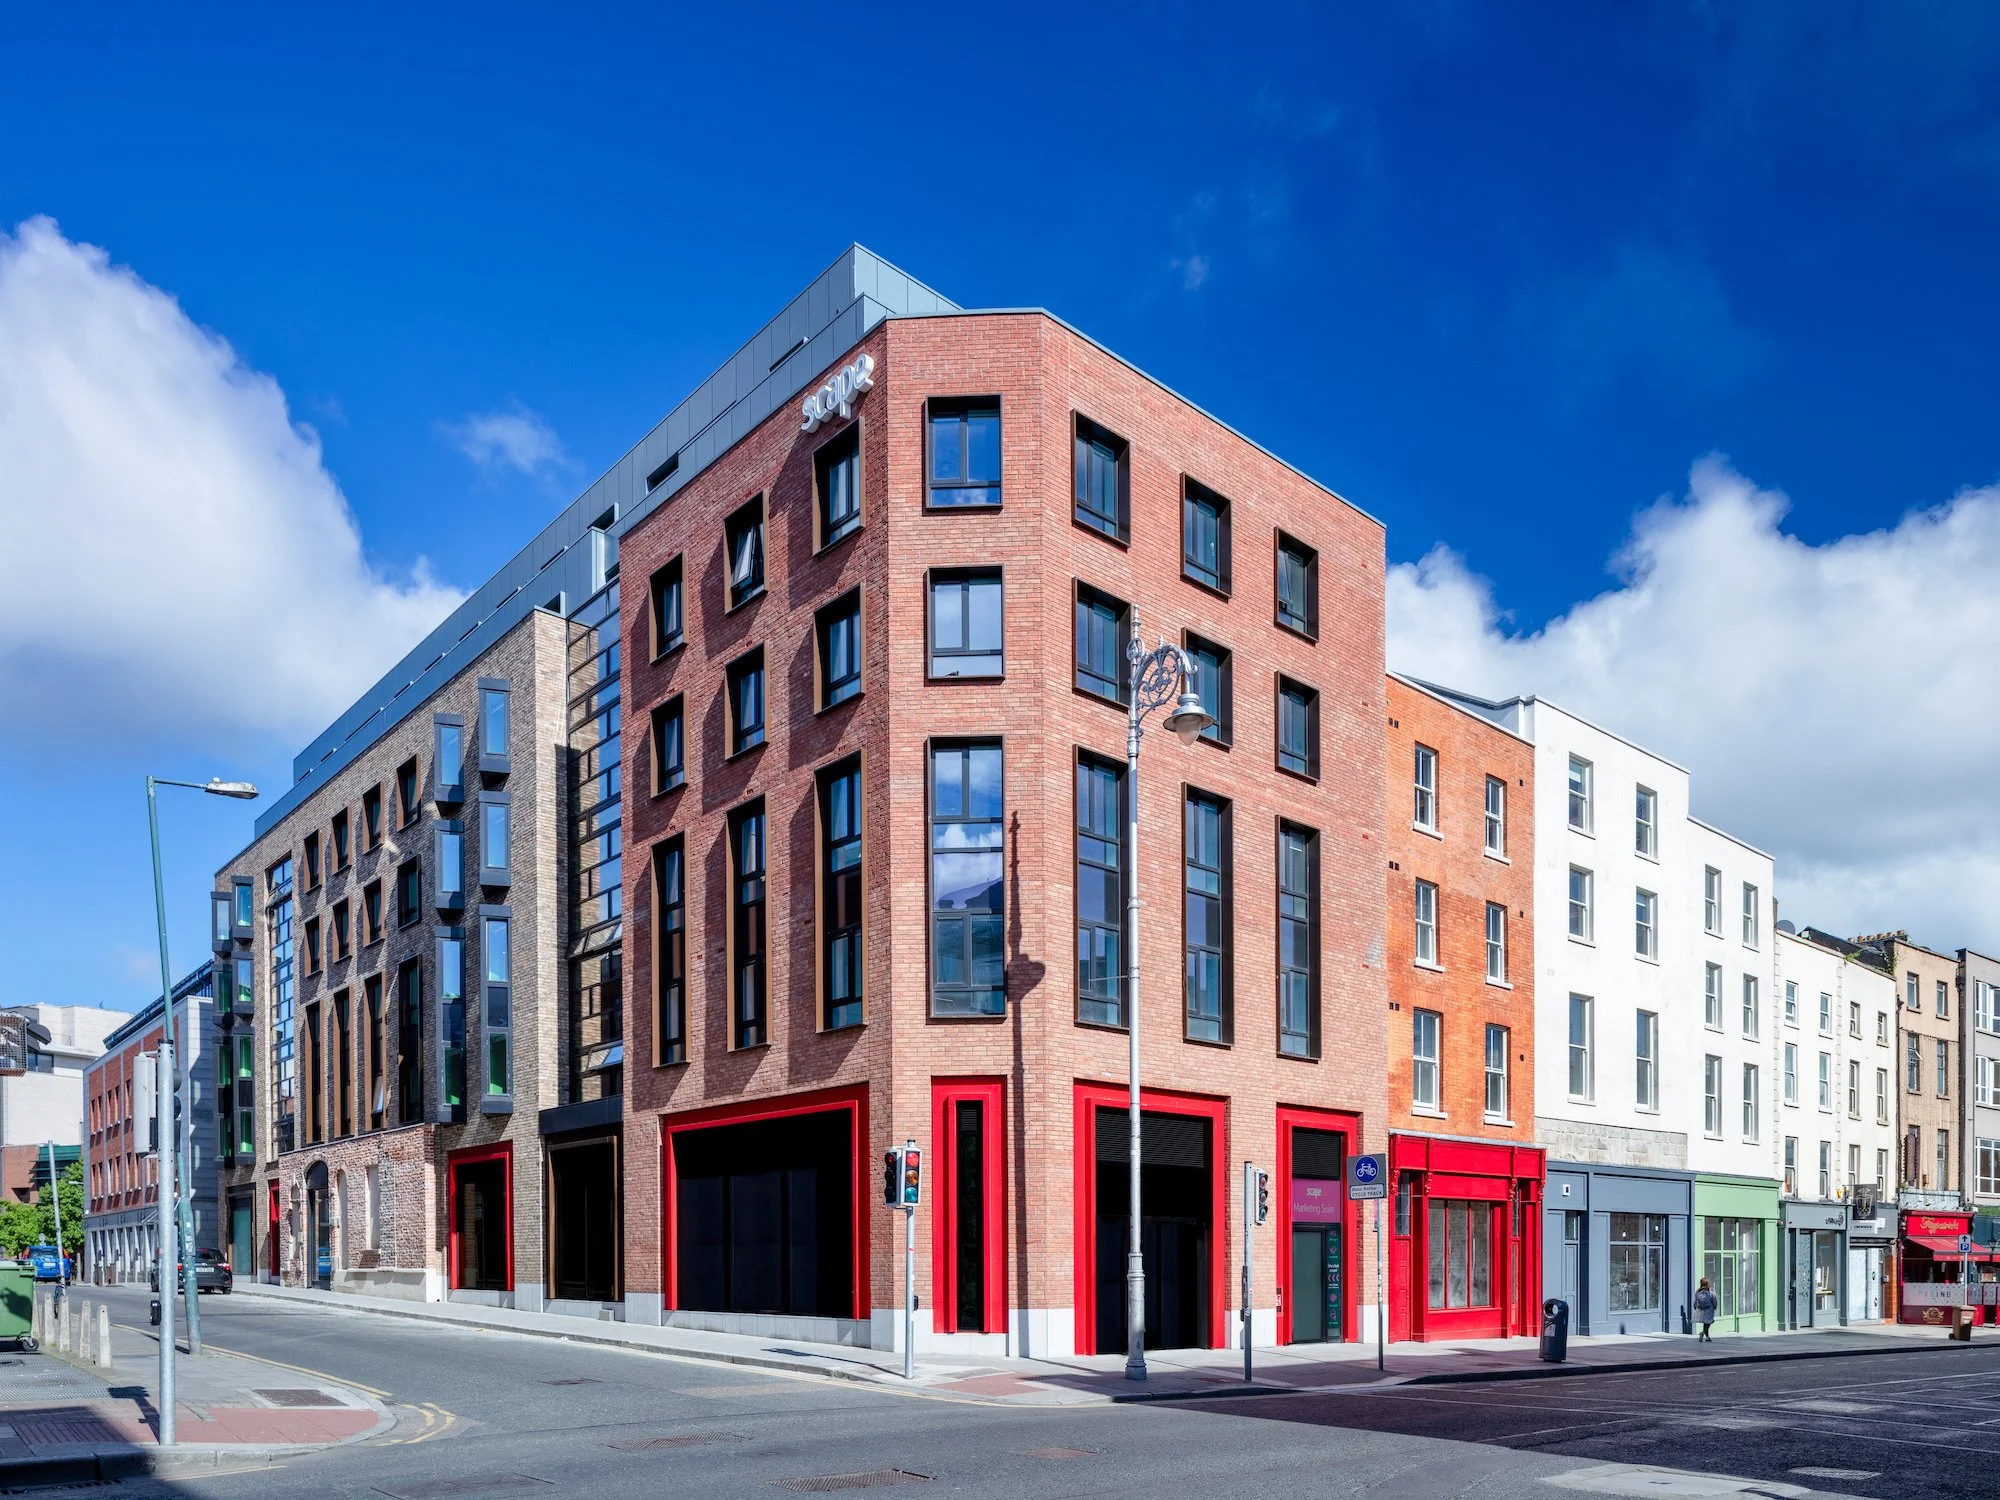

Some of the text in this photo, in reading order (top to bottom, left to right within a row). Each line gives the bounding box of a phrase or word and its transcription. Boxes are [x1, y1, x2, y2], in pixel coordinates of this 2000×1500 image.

[801, 353, 874, 433] scape
[1307, 1187, 1322, 1199] scape
[1293, 1202, 1335, 1215] Marketing Suite
